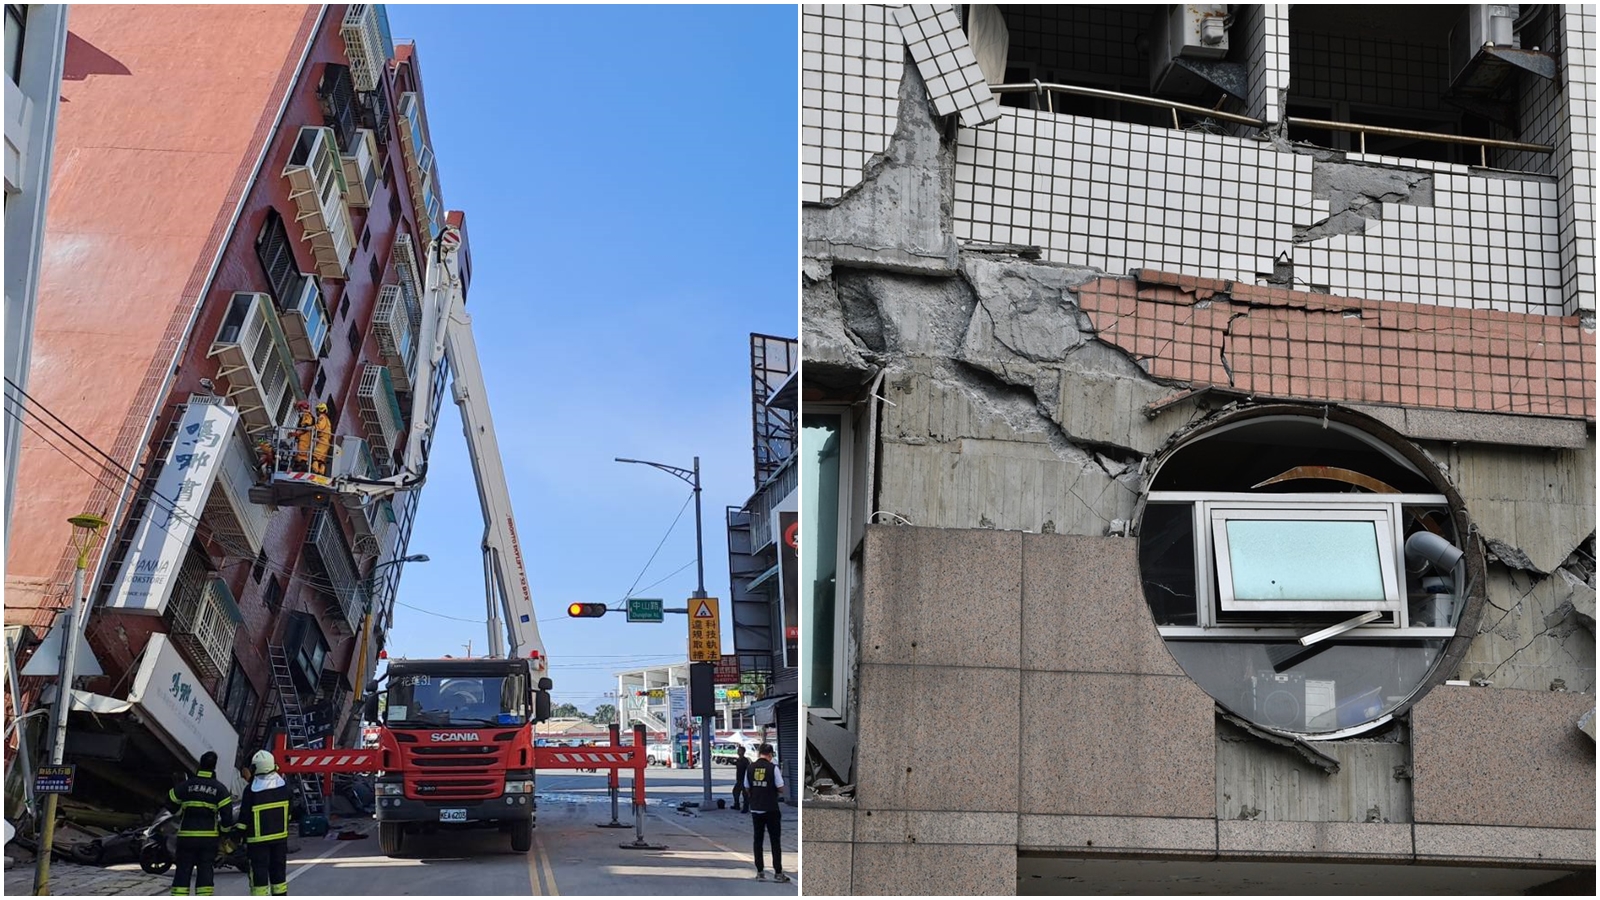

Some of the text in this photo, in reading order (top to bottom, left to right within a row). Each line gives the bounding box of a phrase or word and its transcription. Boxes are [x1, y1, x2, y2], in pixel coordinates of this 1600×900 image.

[124, 575, 166, 585] OOKSTORE
[632, 601, 659, 610] 中山路
[705, 619, 718, 660] 科技執法
[430, 732, 480, 742] SCANIA
